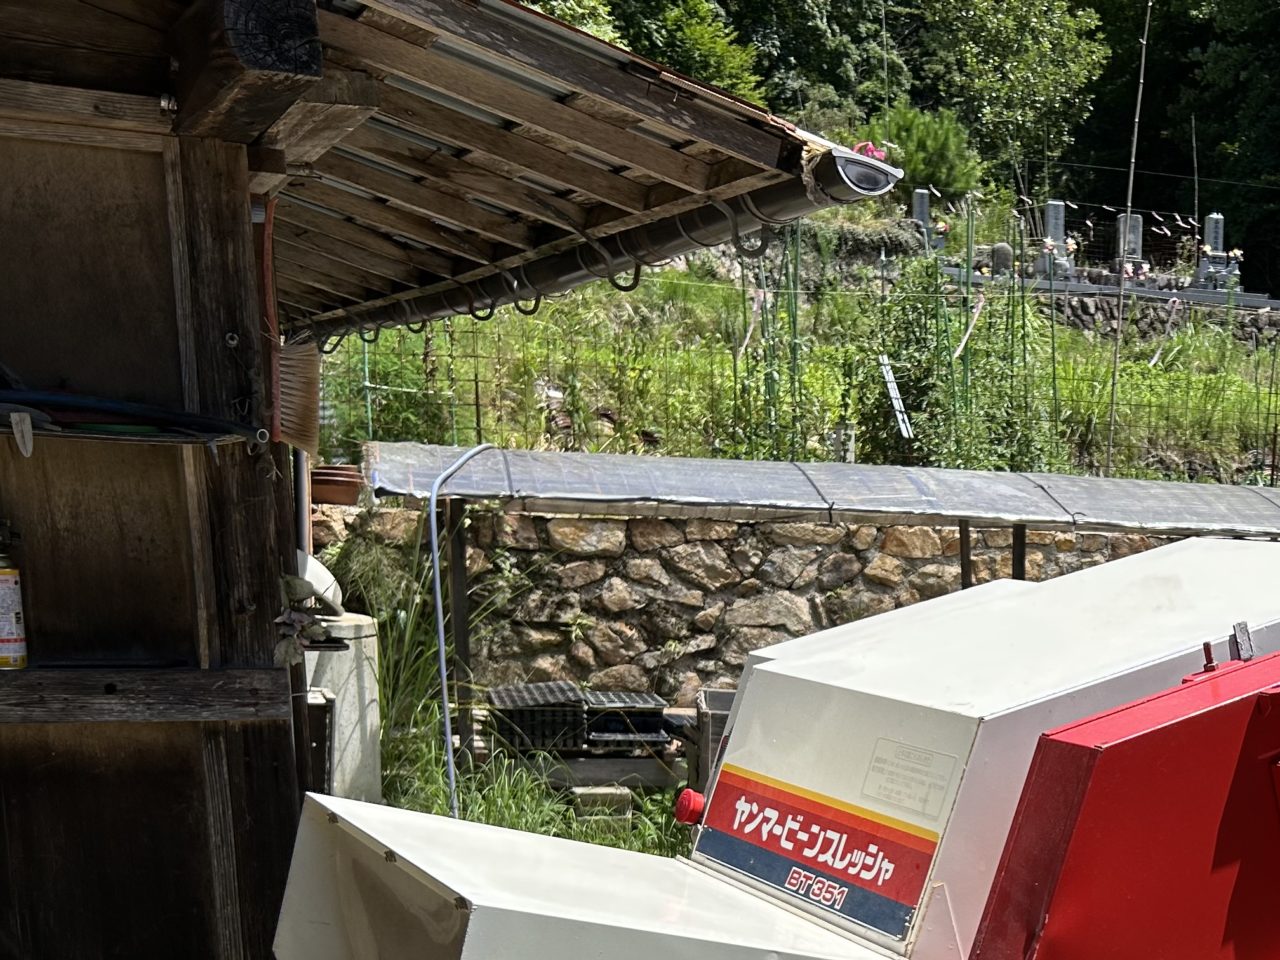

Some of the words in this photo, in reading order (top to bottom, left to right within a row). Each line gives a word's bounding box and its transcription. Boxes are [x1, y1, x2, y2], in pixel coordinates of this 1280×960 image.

[732, 795, 895, 886] ヤンマービーンスレッシャ
[784, 866, 848, 909] BT351
